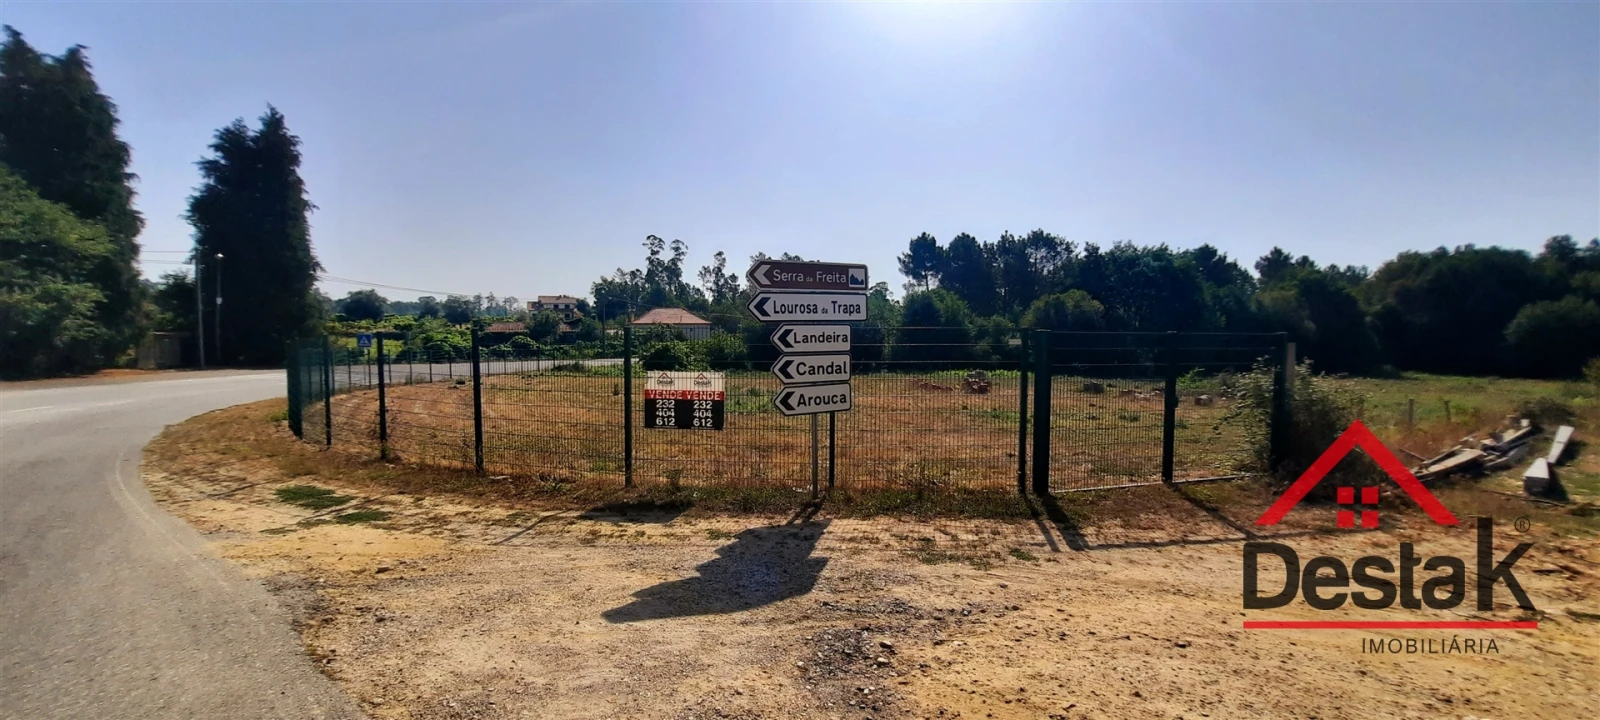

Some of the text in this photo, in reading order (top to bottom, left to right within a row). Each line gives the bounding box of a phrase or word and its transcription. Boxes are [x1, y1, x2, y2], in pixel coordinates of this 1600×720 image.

[773, 269, 804, 282] Serra
[816, 271, 847, 283] Freita
[773, 300, 818, 314] Lourosa
[831, 301, 861, 316] Trapa
[793, 332, 848, 344] Landeira
[796, 361, 847, 376] Candal
[649, 390, 683, 399] VENDE
[686, 391, 721, 400] VENDE
[656, 400, 675, 408] 232
[693, 401, 713, 409] 232
[797, 393, 847, 407] Arouca
[656, 418, 675, 426] 612
